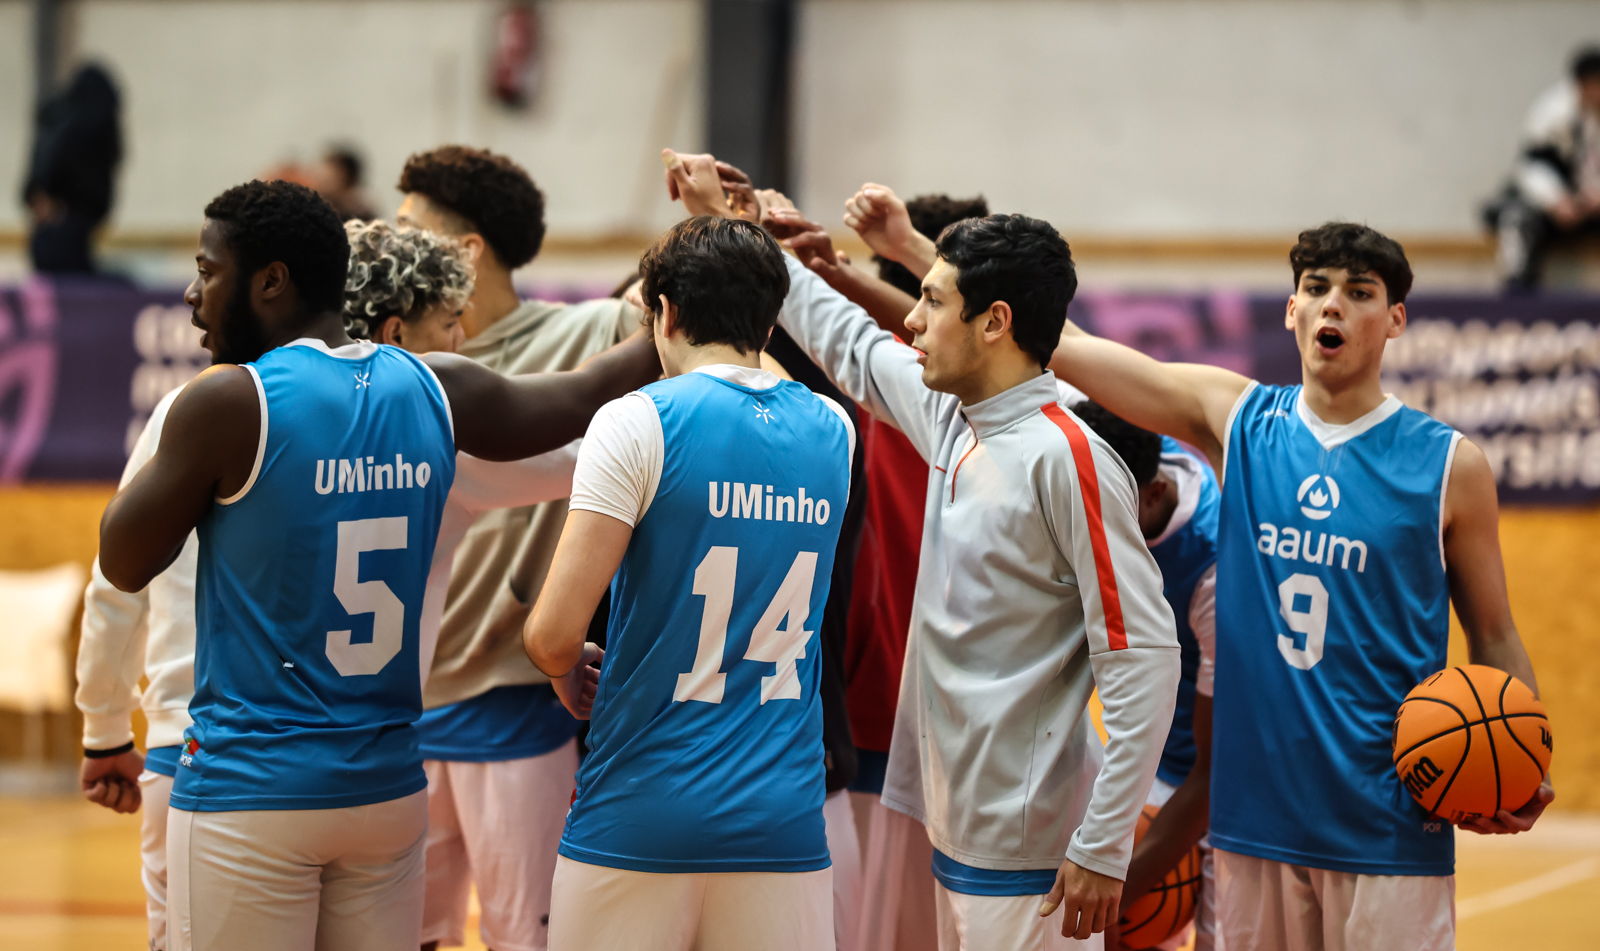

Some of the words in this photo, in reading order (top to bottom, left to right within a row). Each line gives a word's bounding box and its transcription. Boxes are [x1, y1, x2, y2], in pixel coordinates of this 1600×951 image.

[314, 454, 431, 495] UMinho
[708, 481, 831, 526] UMinho
[1257, 522, 1368, 573] aaum
[325, 516, 408, 677] 5
[1277, 573, 1330, 671] 9
[671, 545, 819, 706] 14
[1423, 822, 1441, 833] POR
